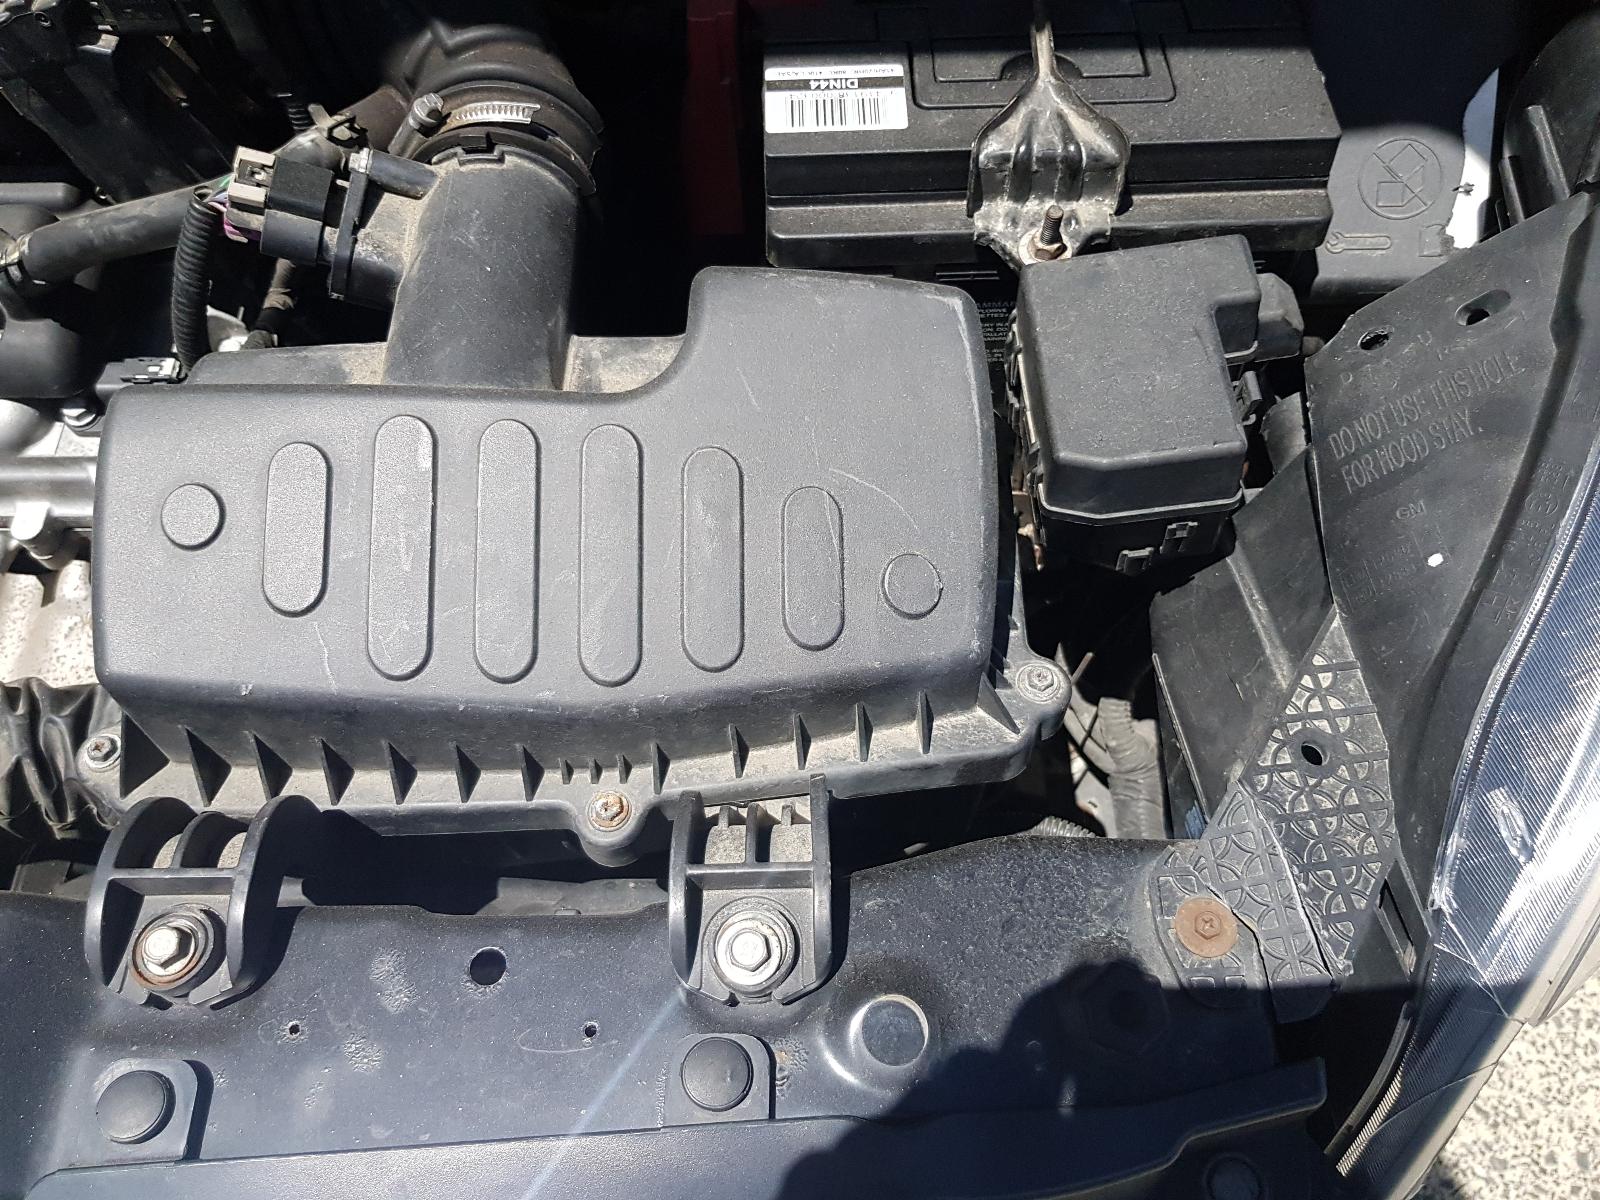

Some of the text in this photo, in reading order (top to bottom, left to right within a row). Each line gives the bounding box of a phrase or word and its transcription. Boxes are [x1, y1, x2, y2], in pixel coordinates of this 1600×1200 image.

[808, 78, 859, 91] DIN44
[1328, 426, 1355, 460] DO
[1352, 408, 1392, 447] NOT
[1388, 389, 1429, 427] USE
[1429, 368, 1472, 411] THIS
[1467, 350, 1527, 393] HOLE
[1340, 408, 1484, 494] FOR HOOD STAY.
[1395, 499, 1427, 520] GM
